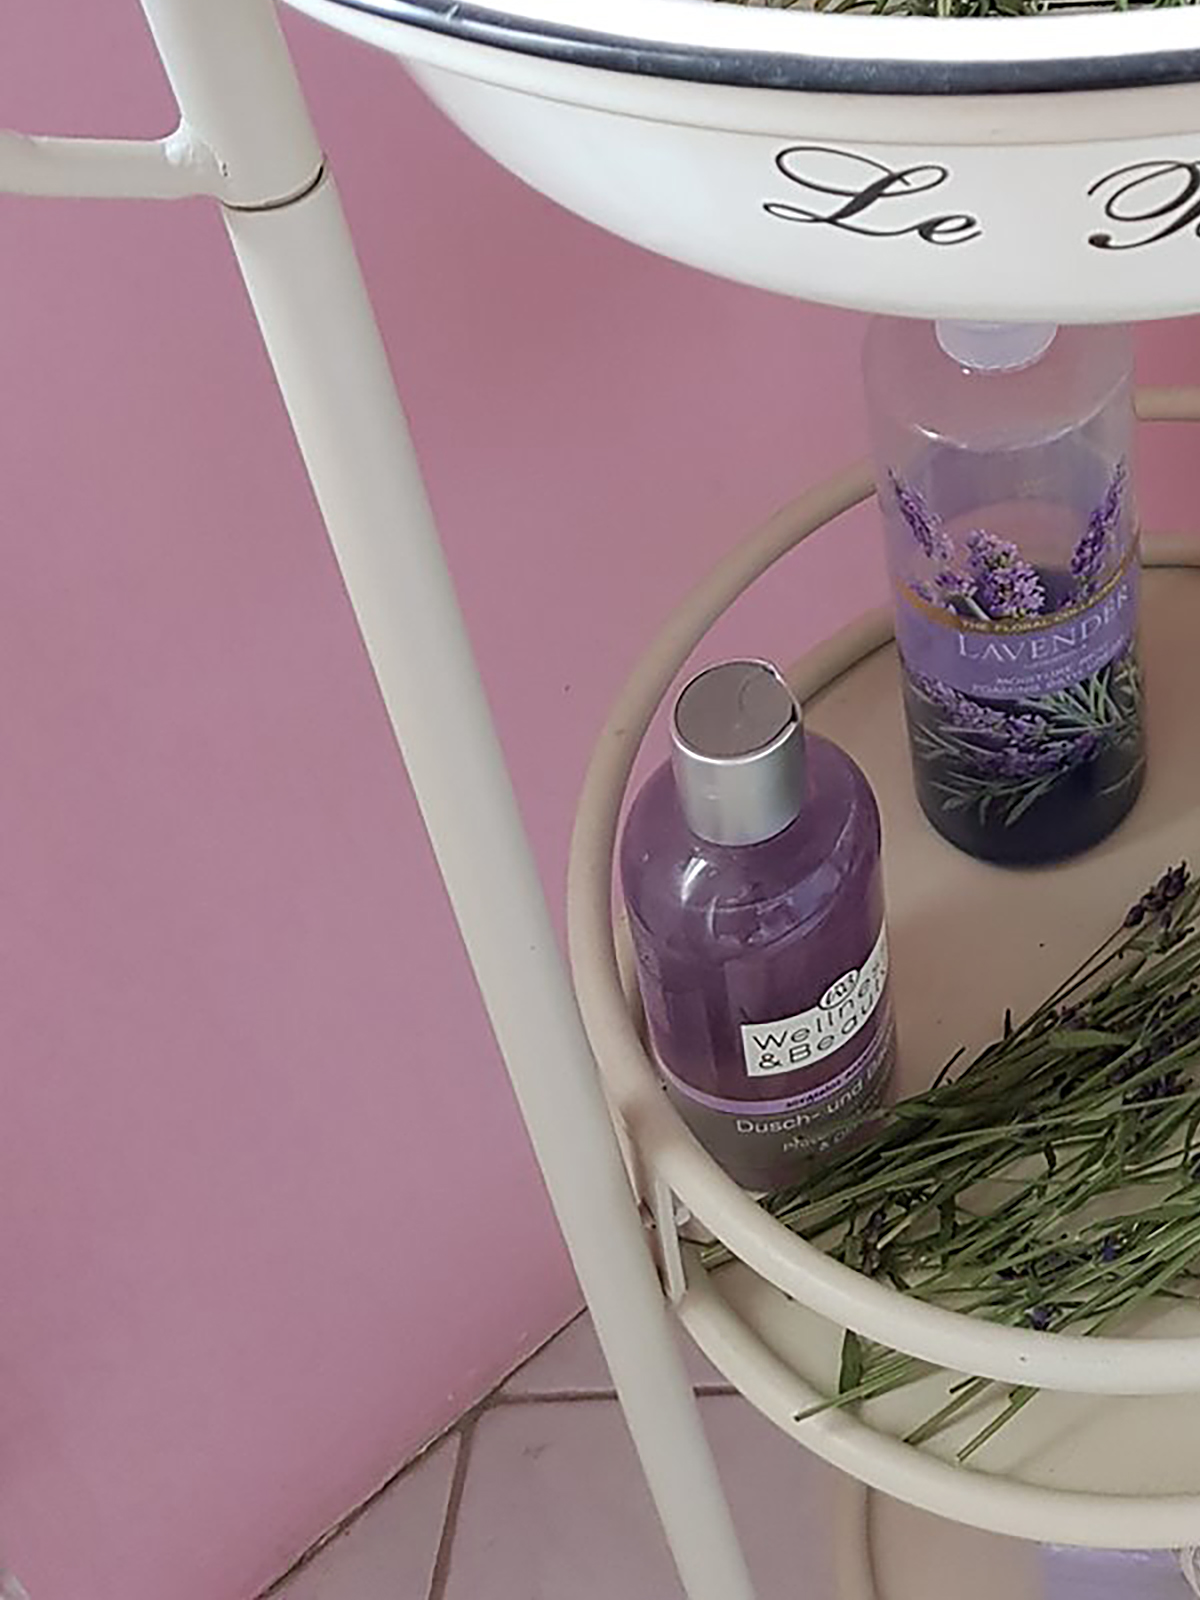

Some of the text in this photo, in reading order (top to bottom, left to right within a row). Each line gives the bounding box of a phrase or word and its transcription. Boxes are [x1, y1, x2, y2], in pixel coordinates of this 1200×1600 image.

[763, 146, 982, 245] Le
[959, 585, 1129, 662] LAVENDER
[736, 1111, 820, 1134] Dusch-
[827, 1078, 864, 1114] und
